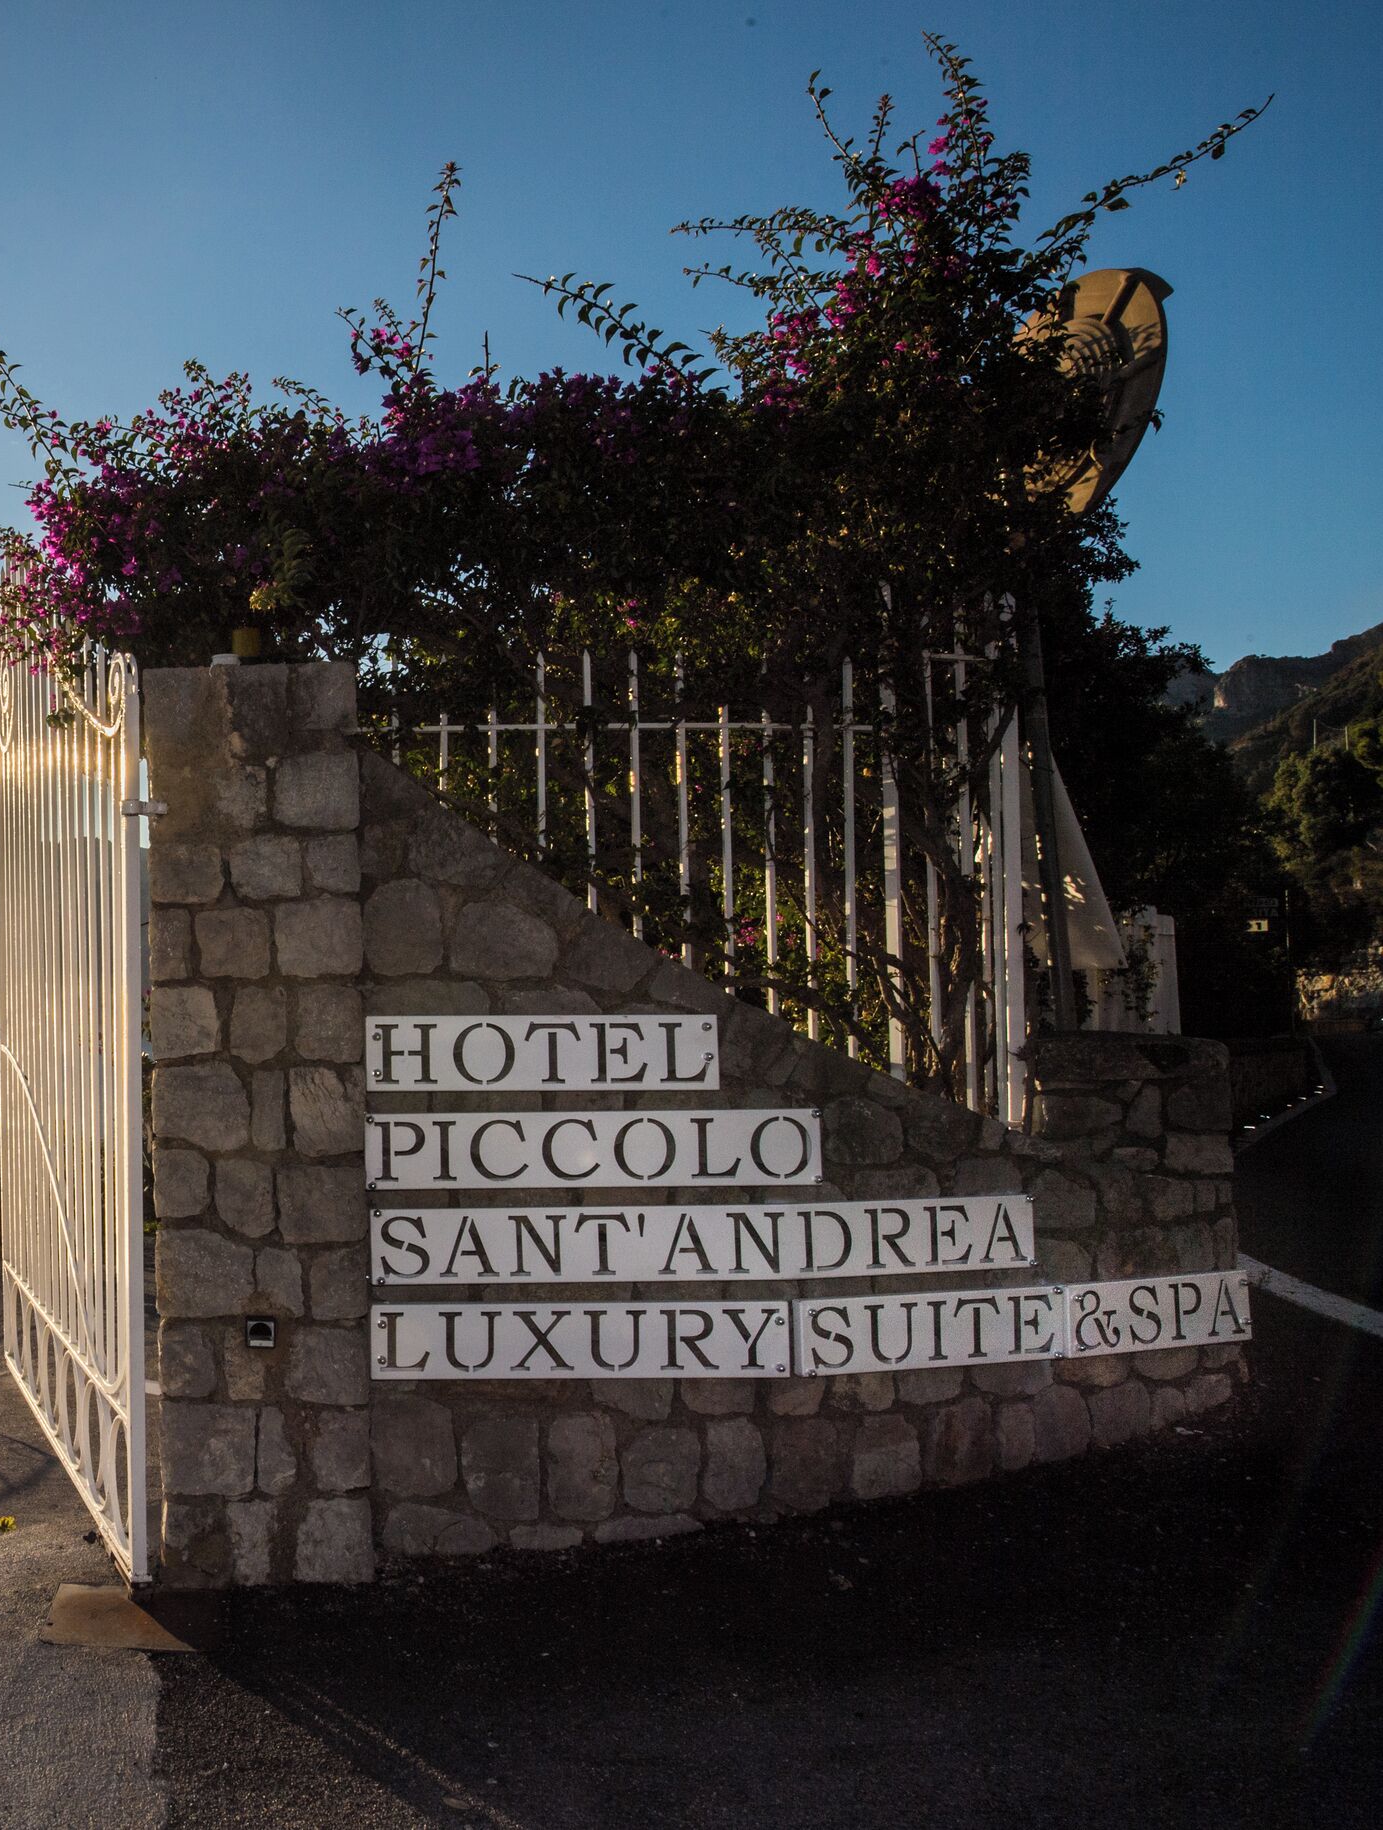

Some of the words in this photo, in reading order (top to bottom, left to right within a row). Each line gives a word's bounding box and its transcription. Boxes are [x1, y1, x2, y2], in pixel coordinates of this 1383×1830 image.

[375, 1021, 709, 1084] HOTEL
[374, 1116, 812, 1182] PICCOLO
[380, 1203, 1028, 1278] SANT'ANDREA
[379, 1308, 780, 1372] LUXURY
[811, 1295, 1055, 1369] SUITE
